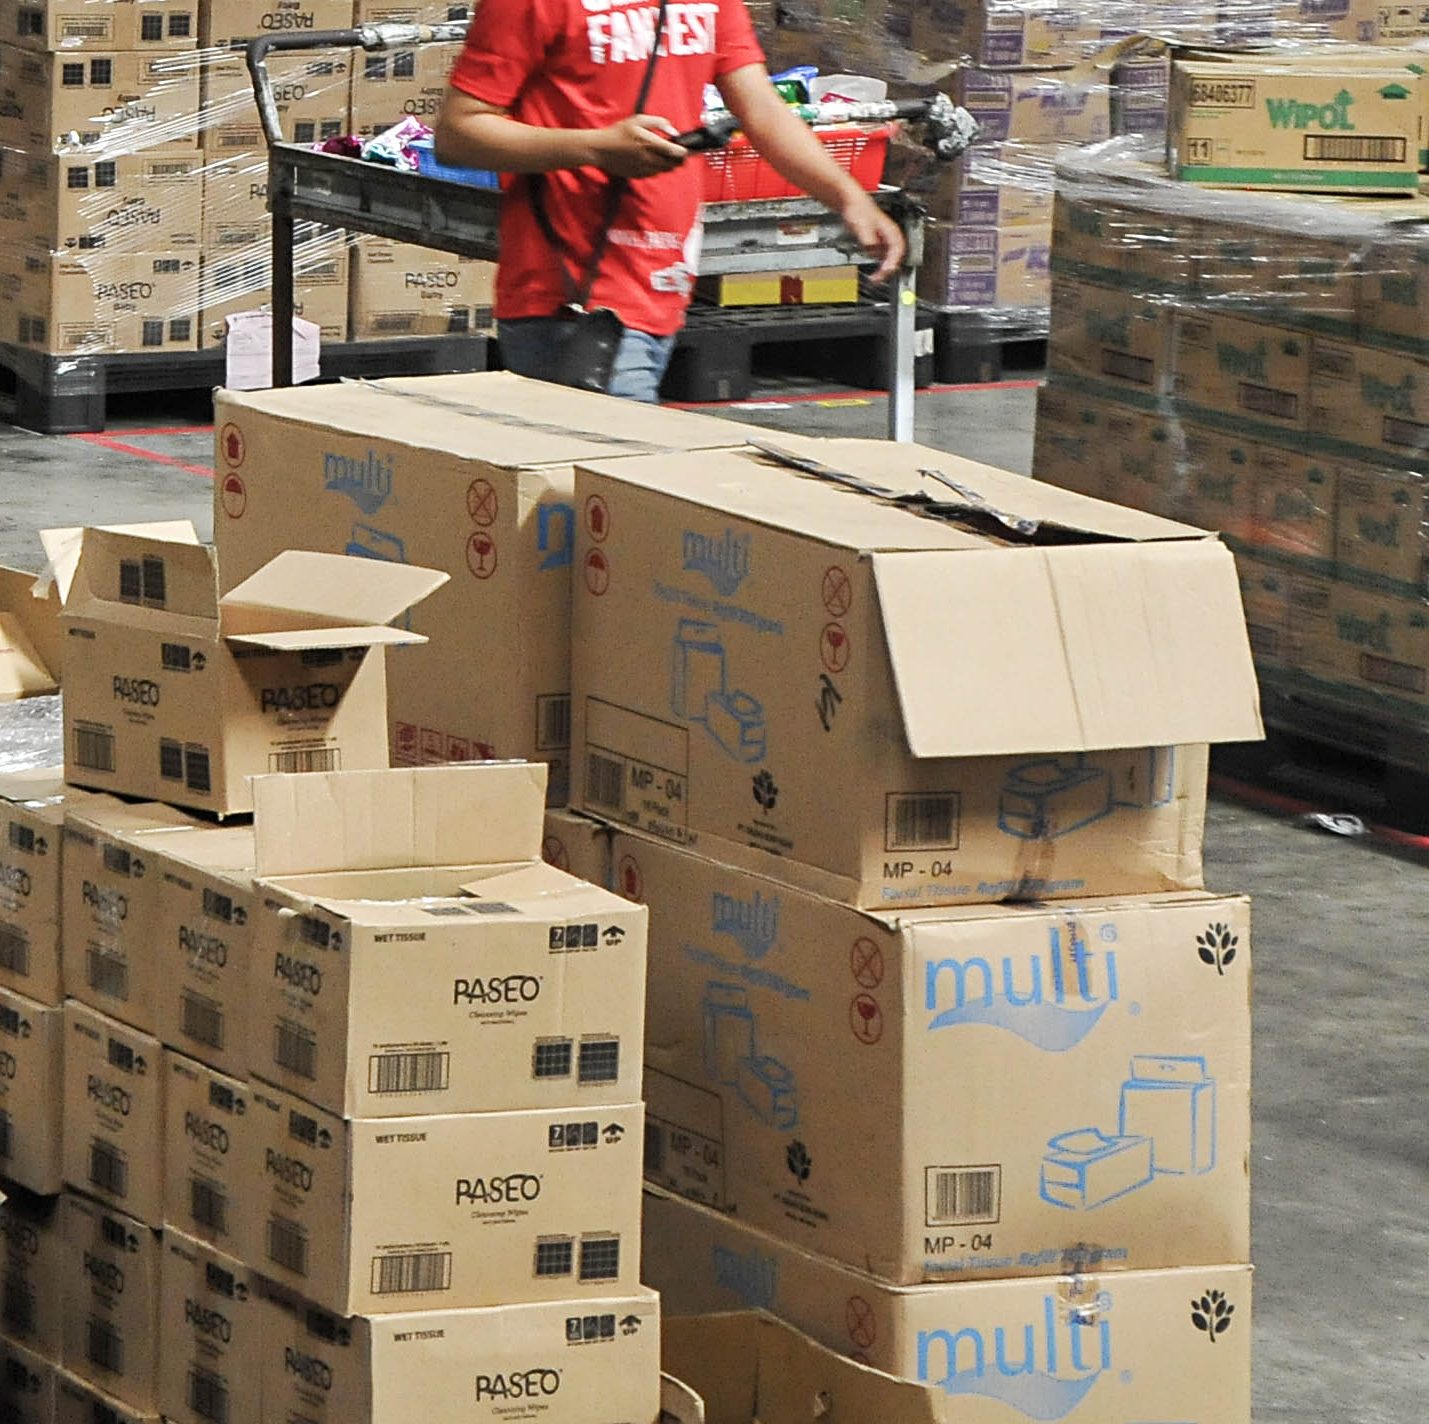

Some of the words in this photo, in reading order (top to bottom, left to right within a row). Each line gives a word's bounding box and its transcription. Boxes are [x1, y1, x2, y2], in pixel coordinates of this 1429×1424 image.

[260, 12, 315, 30] PASEO
[1266, 89, 1355, 131] WIPOL
[1189, 140, 1209, 161] 11
[97, 281, 152, 301] PASEO
[405, 272, 457, 289] PASEO
[113, 677, 160, 707] PASEO
[261, 682, 340, 713] PASEO
[883, 862, 914, 878] MP
[931, 861, 953, 877] 04
[374, 932, 394, 943] WET
[395, 931, 426, 943] TISSUE
[274, 952, 323, 996] PASEO
[923, 926, 1119, 1010] multi
[453, 975, 541, 1006] PASEO
[375, 1133, 396, 1144] WET
[398, 1132, 428, 1143] TISSUE
[455, 1174, 541, 1206] PASEO
[923, 1237, 955, 1255] MP
[970, 1233, 993, 1252] 04
[392, 1331, 414, 1342] WET
[415, 1329, 446, 1341] TISSUE
[916, 1294, 1111, 1381] multi
[475, 1369, 560, 1402] PASEO
